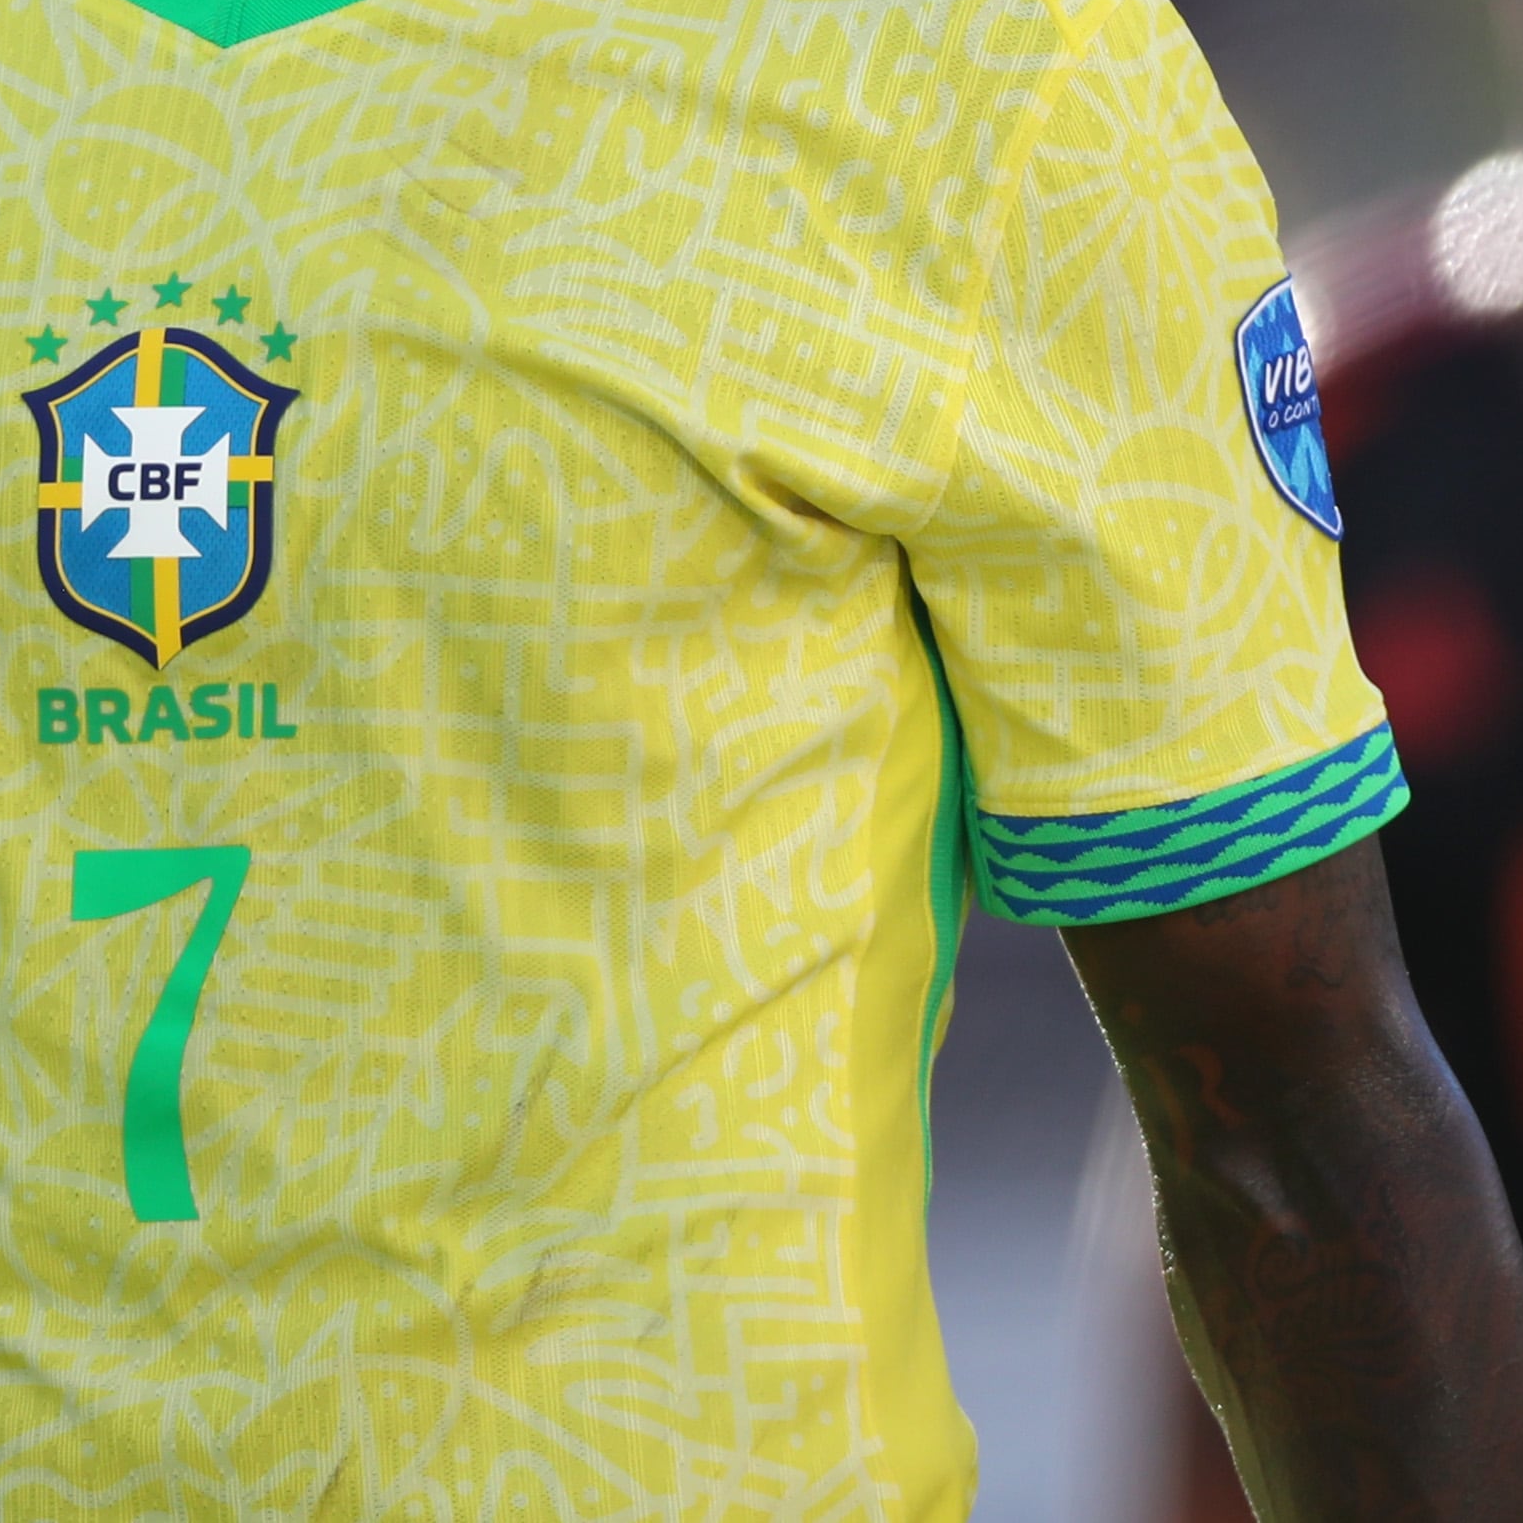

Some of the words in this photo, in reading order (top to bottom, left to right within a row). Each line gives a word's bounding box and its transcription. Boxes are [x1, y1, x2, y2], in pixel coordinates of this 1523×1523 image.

[1268, 410, 1279, 428] O
[108, 462, 203, 501] CBF
[38, 682, 298, 744] BRASIL
[70, 843, 252, 1223] 7
